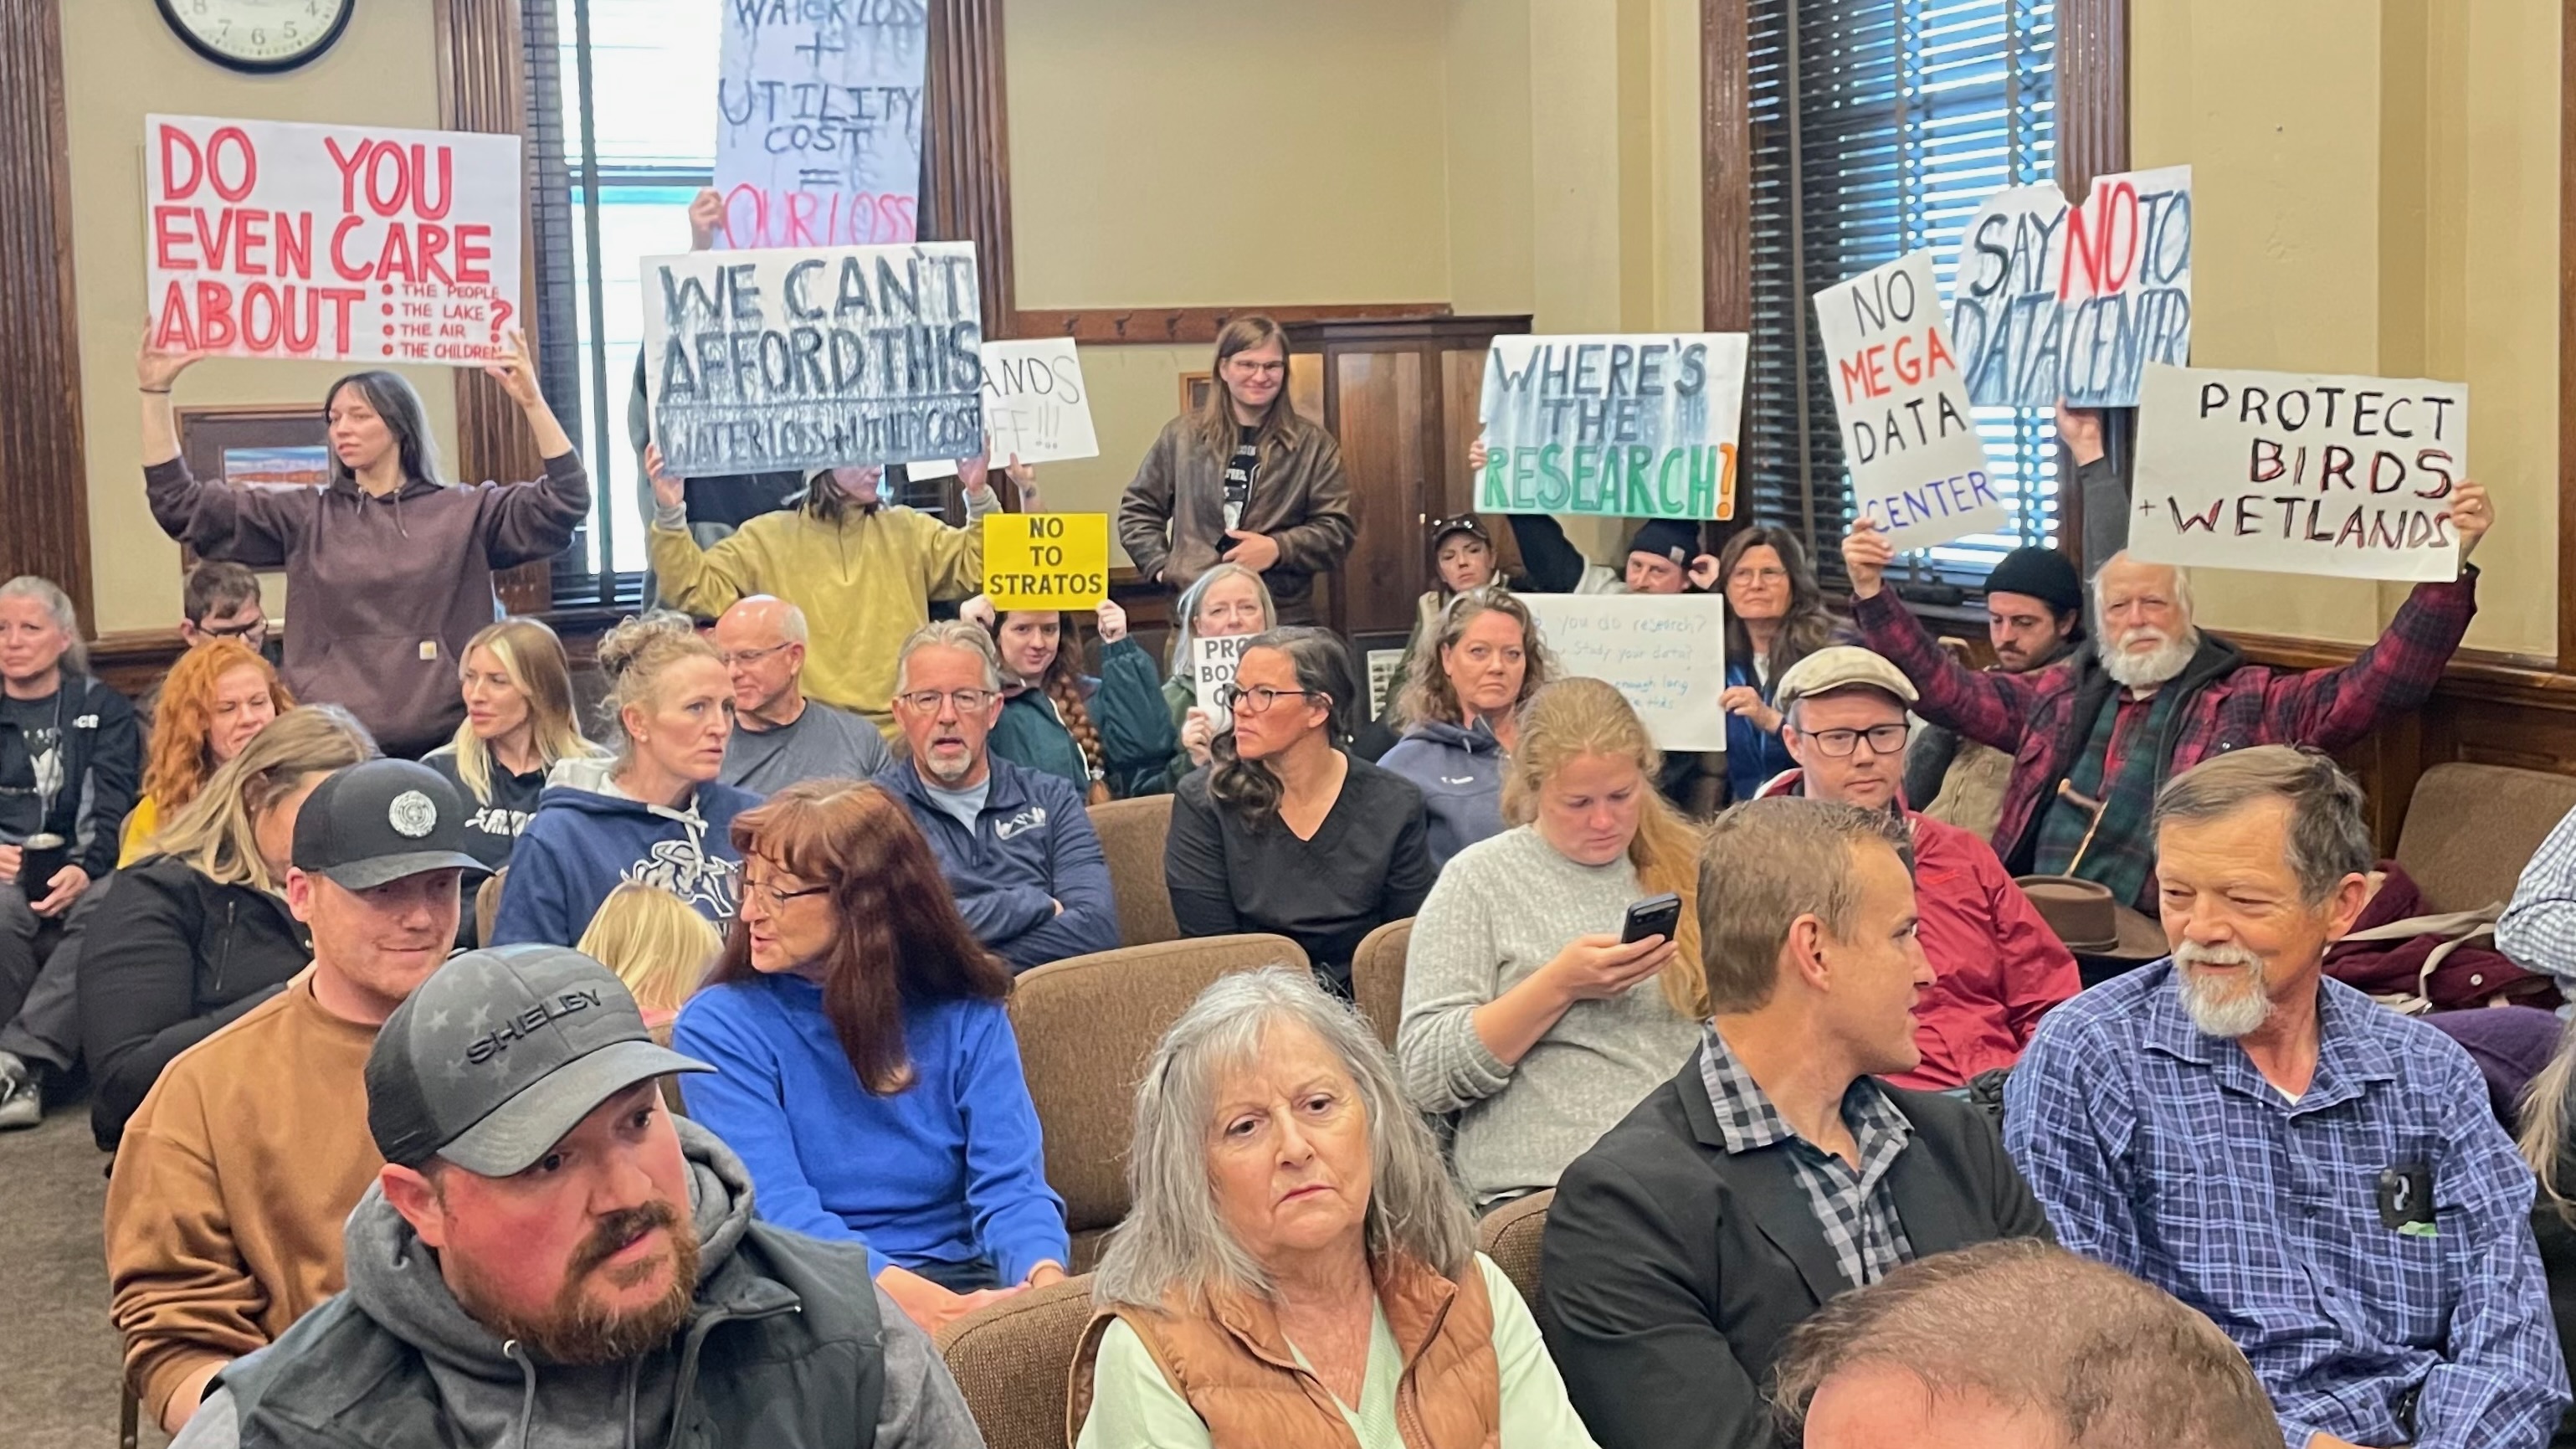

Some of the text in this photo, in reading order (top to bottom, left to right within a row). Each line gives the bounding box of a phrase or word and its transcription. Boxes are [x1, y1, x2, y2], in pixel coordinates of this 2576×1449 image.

[218, 19, 232, 37] 7
[252, 28, 265, 45] 6
[284, 21, 298, 39] 5
[720, 78, 921, 135] UTILITY
[765, 125, 873, 155] COST
[160, 124, 452, 220] DO YOU
[155, 206, 491, 285] EVEN CARE
[1970, 182, 2191, 301] SAY NO TO
[156, 280, 366, 354] ABOUT
[402, 284, 500, 300] THE PEOPLE
[402, 303, 433, 317] THE
[443, 304, 484, 321] LAKE
[659, 264, 763, 326] WE
[1852, 270, 1915, 337] NO
[401, 323, 466, 338] THE AIR
[401, 342, 429, 357] THE
[659, 326, 867, 400] AFFORD
[983, 355, 1080, 404] ANDS
[1492, 337, 1708, 397] WHERE'S
[1840, 326, 1956, 405] MEGA
[1542, 398, 1641, 442] THE
[1853, 391, 1967, 465] DATA
[2200, 383, 2454, 440] PROTECT
[2250, 438, 2453, 499] BIRDS
[1029, 517, 1064, 539] NO
[1867, 470, 1999, 533] CENTER
[2168, 496, 2453, 550] WETLANDS
[1030, 545, 1063, 567] TO
[989, 573, 1102, 595] STRATOS
